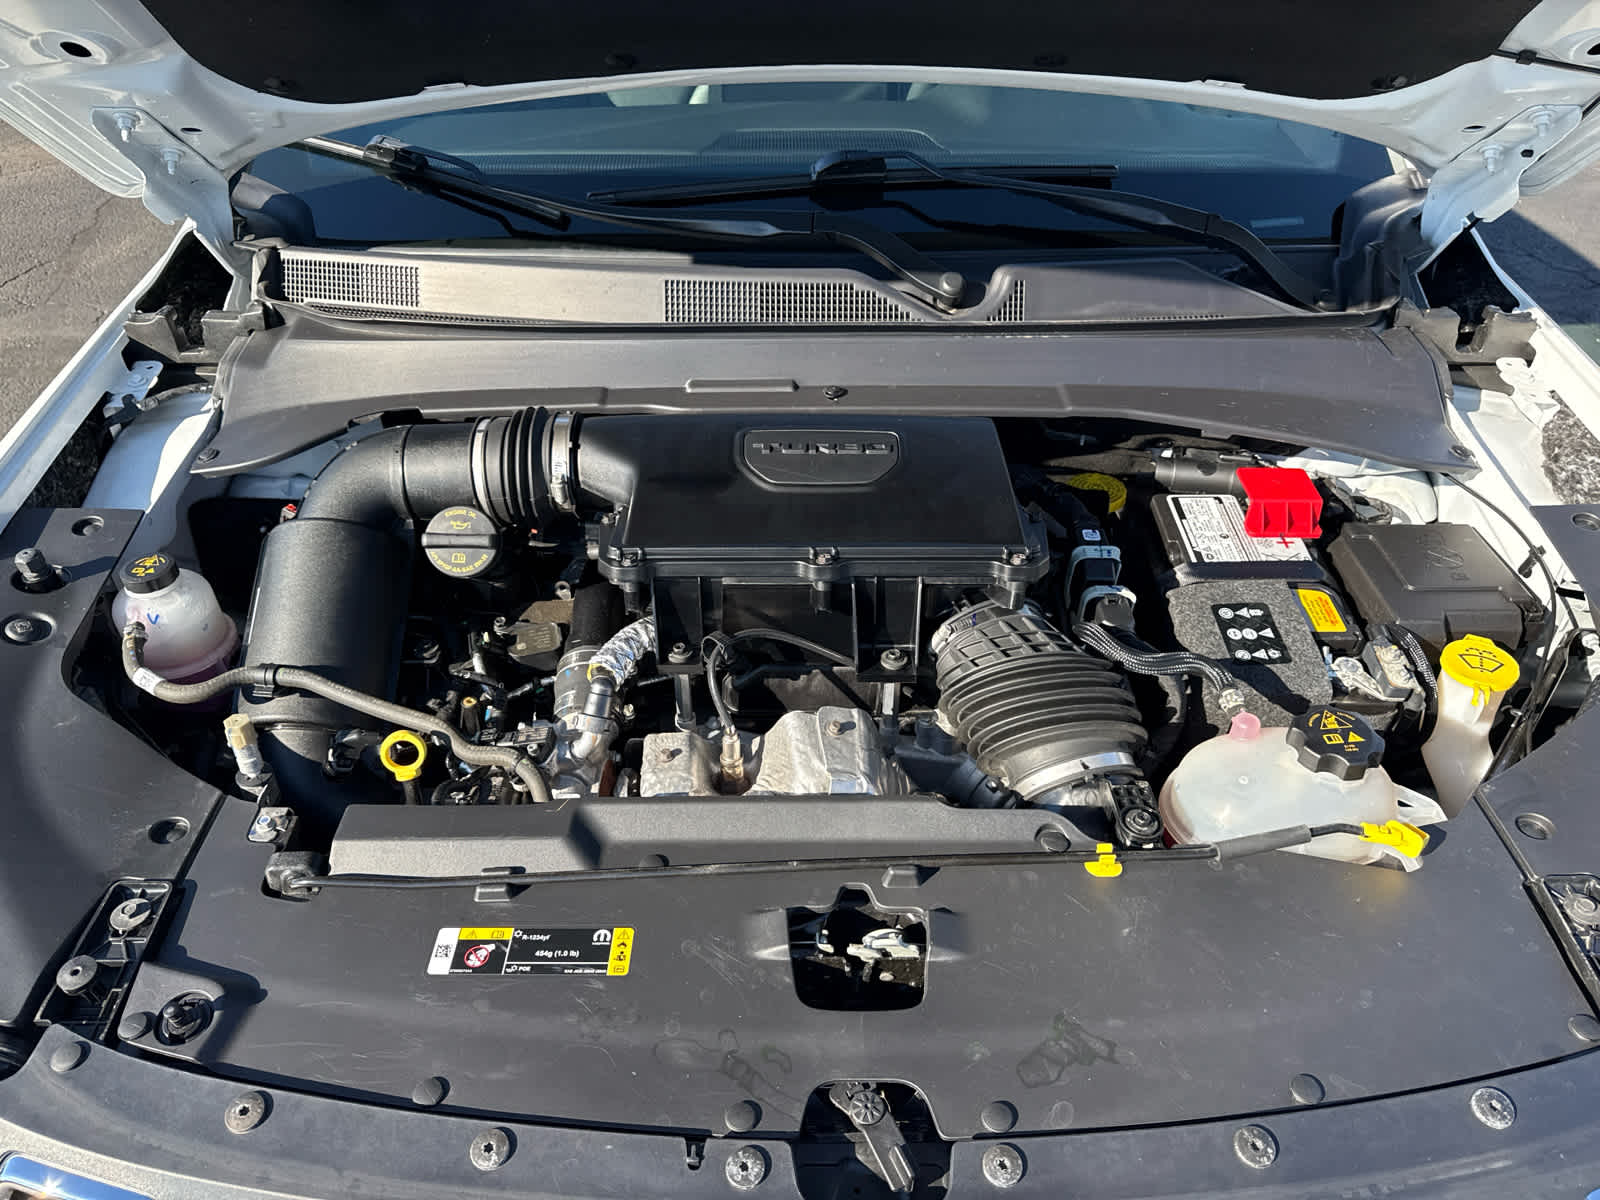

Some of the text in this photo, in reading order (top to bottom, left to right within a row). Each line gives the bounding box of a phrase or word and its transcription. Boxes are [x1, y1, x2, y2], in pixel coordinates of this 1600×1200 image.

[751, 441, 894, 455] TURBO
[534, 949, 580, 958] 454g (1.0 lb)
